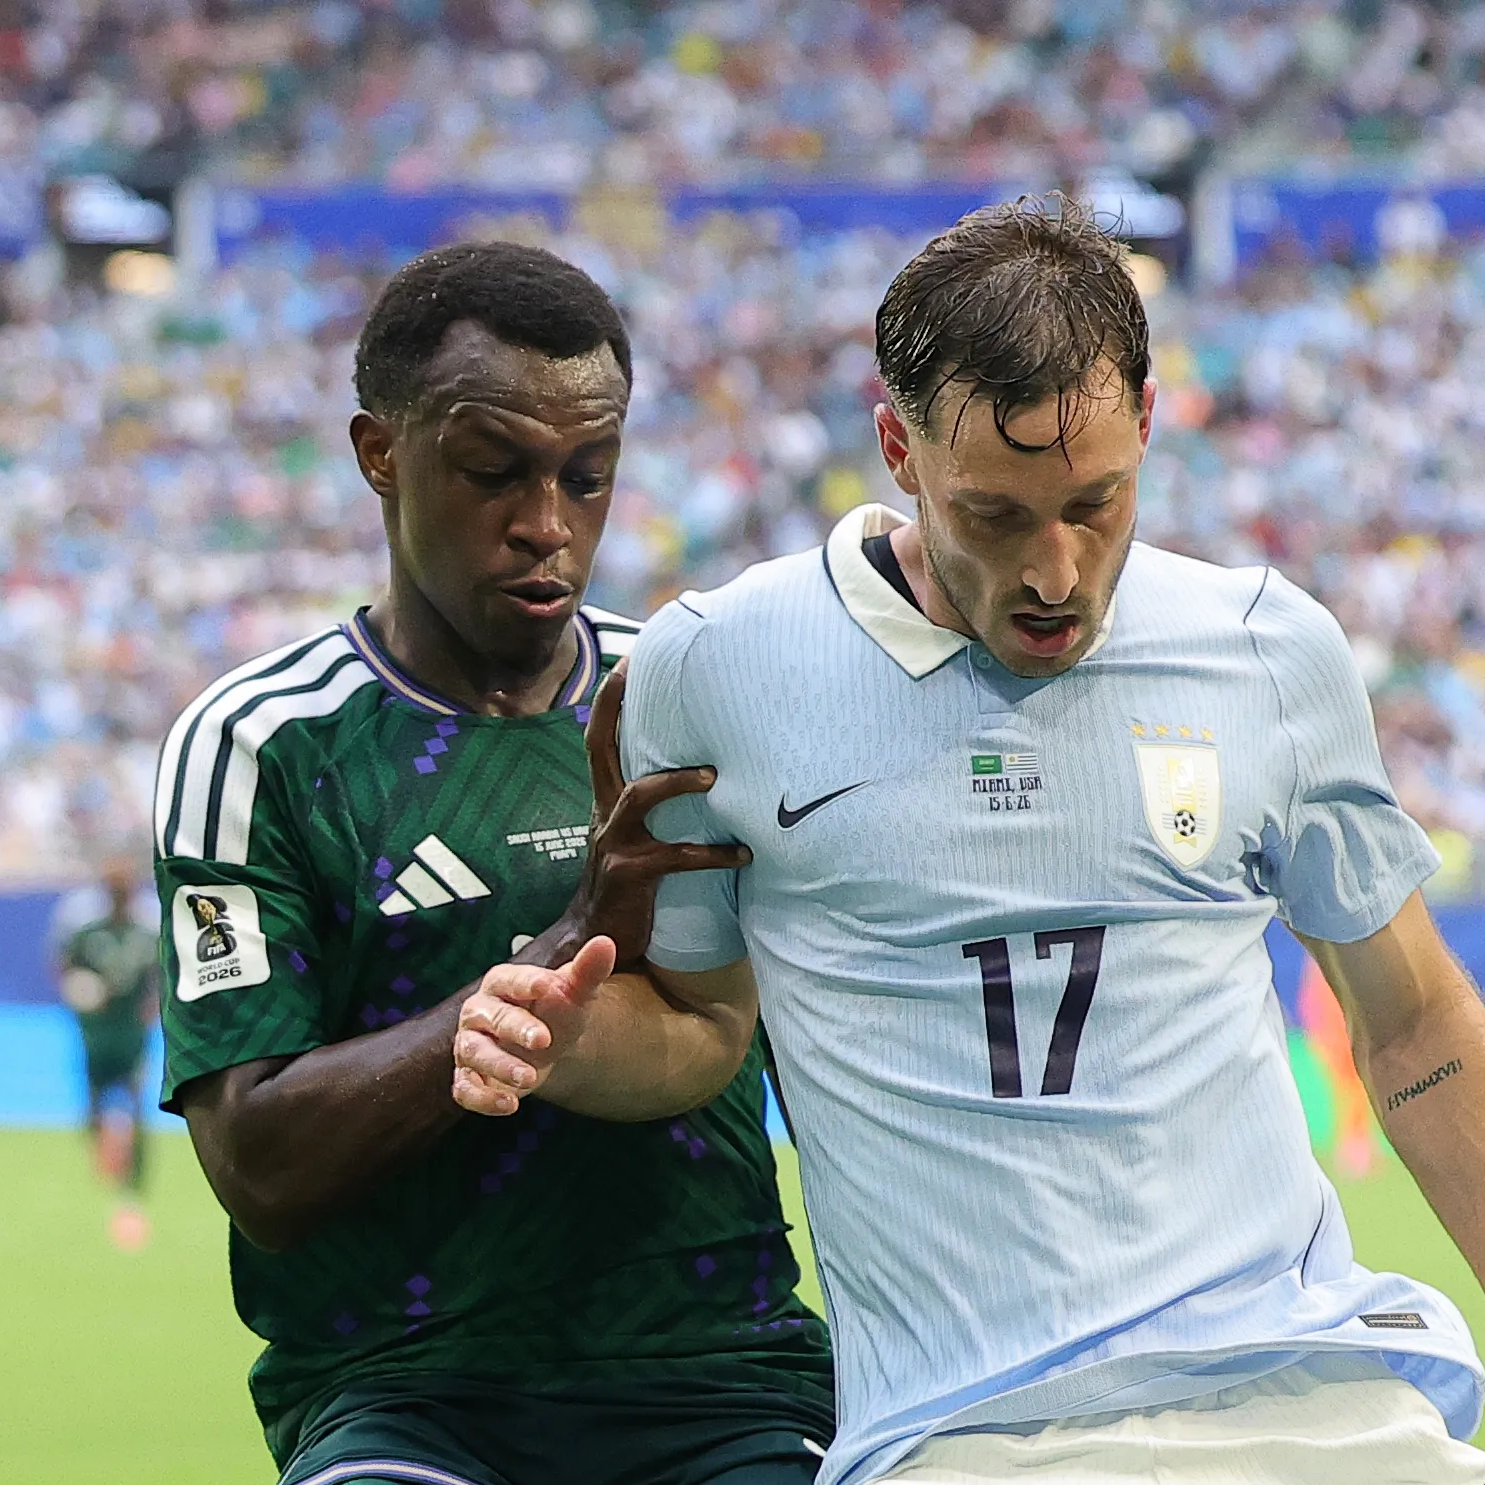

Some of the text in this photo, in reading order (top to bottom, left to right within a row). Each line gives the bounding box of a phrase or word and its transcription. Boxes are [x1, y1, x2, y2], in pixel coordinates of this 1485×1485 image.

[1019, 775, 1042, 791] USA
[207, 942, 227, 957] FIFA
[197, 957, 241, 975] WORLD CUP
[197, 966, 243, 986] 2026
[961, 925, 1108, 1098] 17
